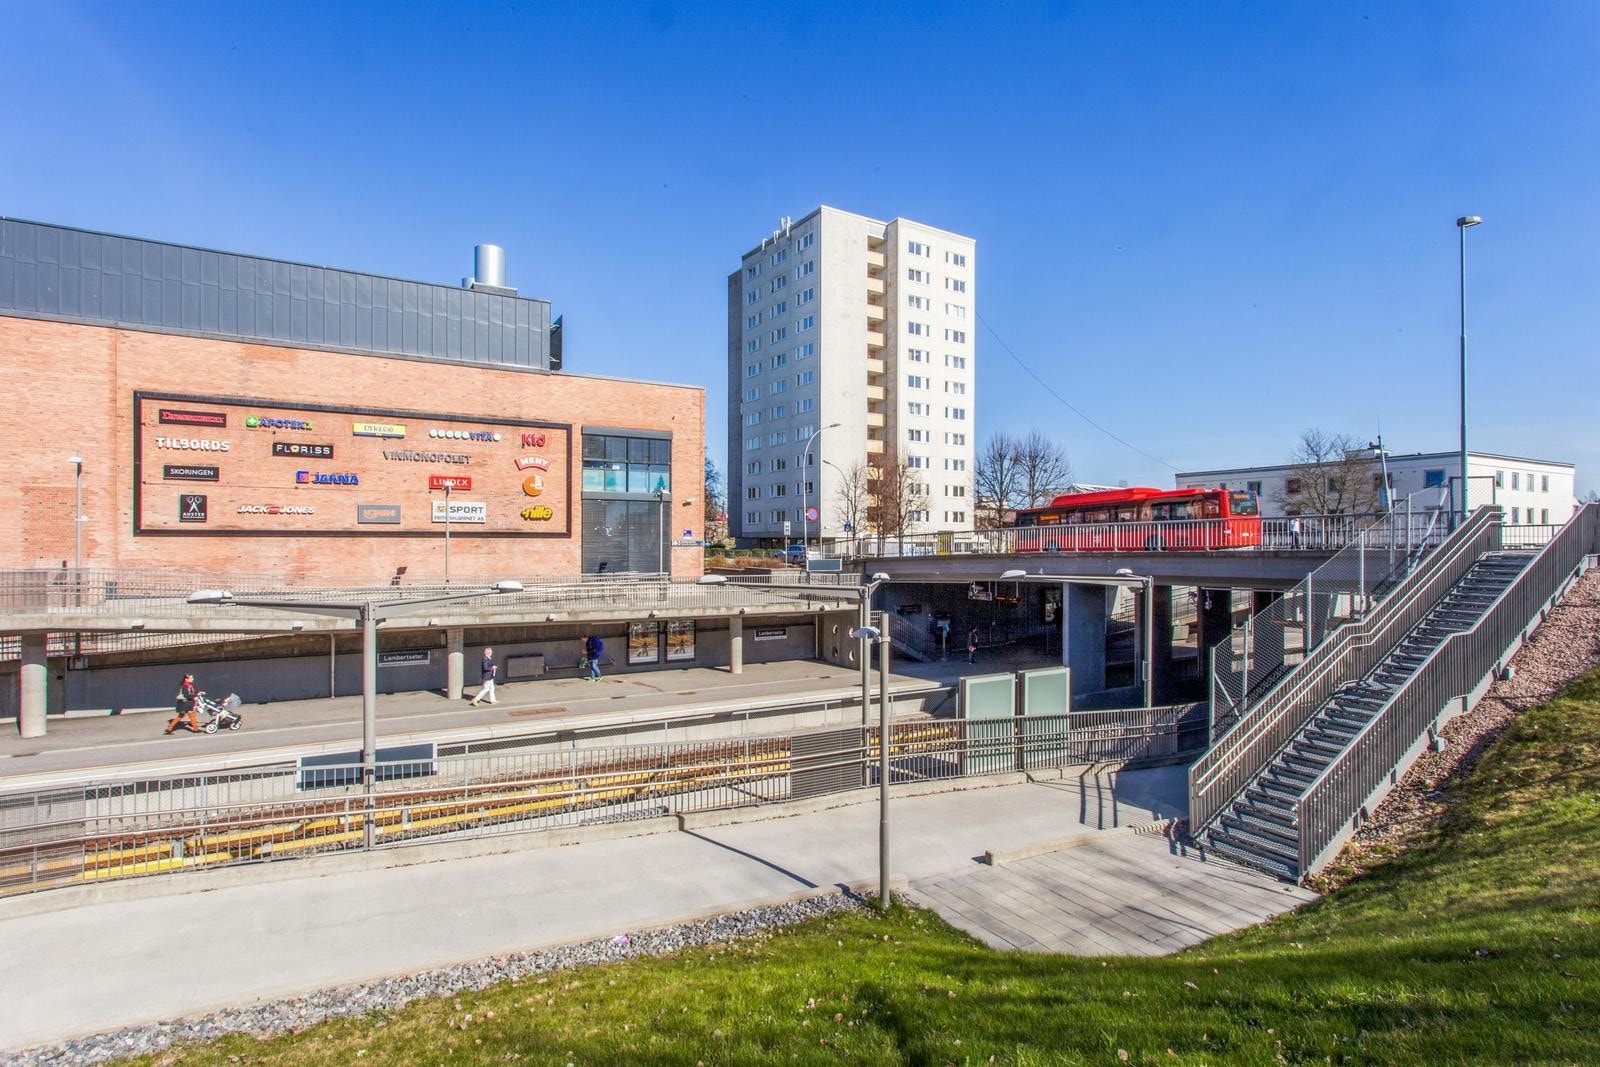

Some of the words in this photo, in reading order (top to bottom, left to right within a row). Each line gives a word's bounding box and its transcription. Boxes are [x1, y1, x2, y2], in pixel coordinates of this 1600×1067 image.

[155, 437, 230, 450] TILBORDS
[522, 433, 546, 448] Kid
[276, 444, 331, 455] FLORISS
[383, 450, 471, 464] VINMONOPOLET
[520, 456, 549, 466] MENY
[433, 478, 468, 486] LINDEX
[237, 505, 269, 513] JACK
[278, 506, 315, 514] JONES
[449, 506, 484, 514] SPORT
[525, 505, 552, 519] nille
